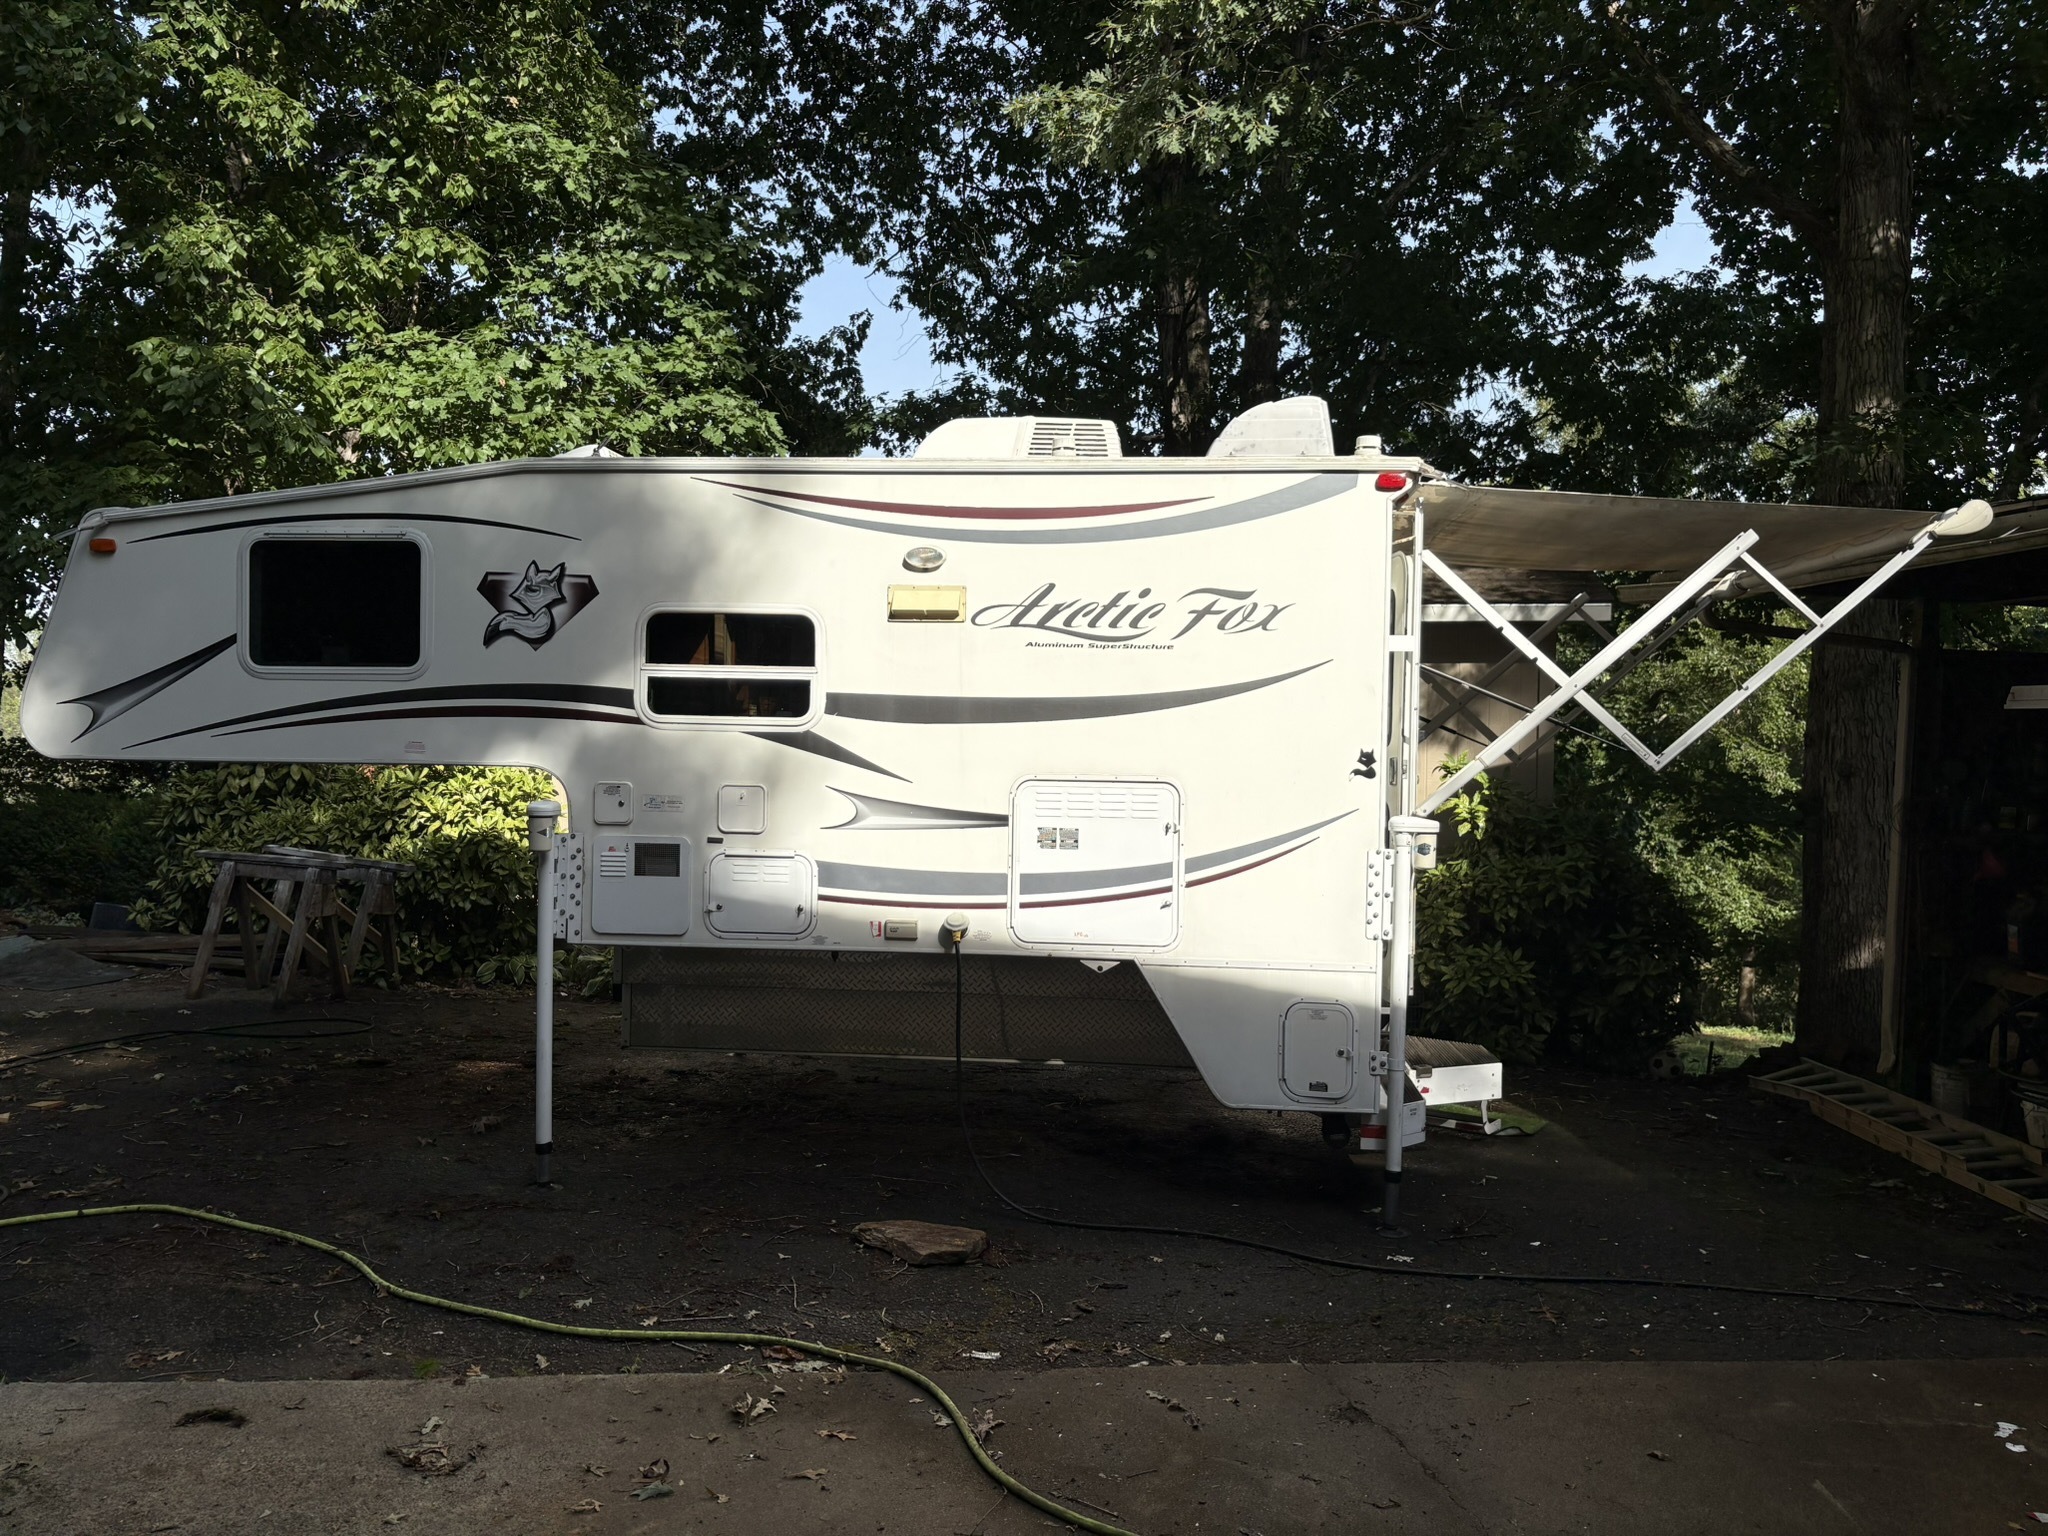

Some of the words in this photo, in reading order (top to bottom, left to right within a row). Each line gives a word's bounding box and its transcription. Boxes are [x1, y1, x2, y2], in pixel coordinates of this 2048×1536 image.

[970, 582, 1167, 642] Arctic
[1169, 587, 1297, 641] Fox
[1024, 641, 1084, 649] Aluminum
[1087, 642, 1175, 650] SuperStructure
